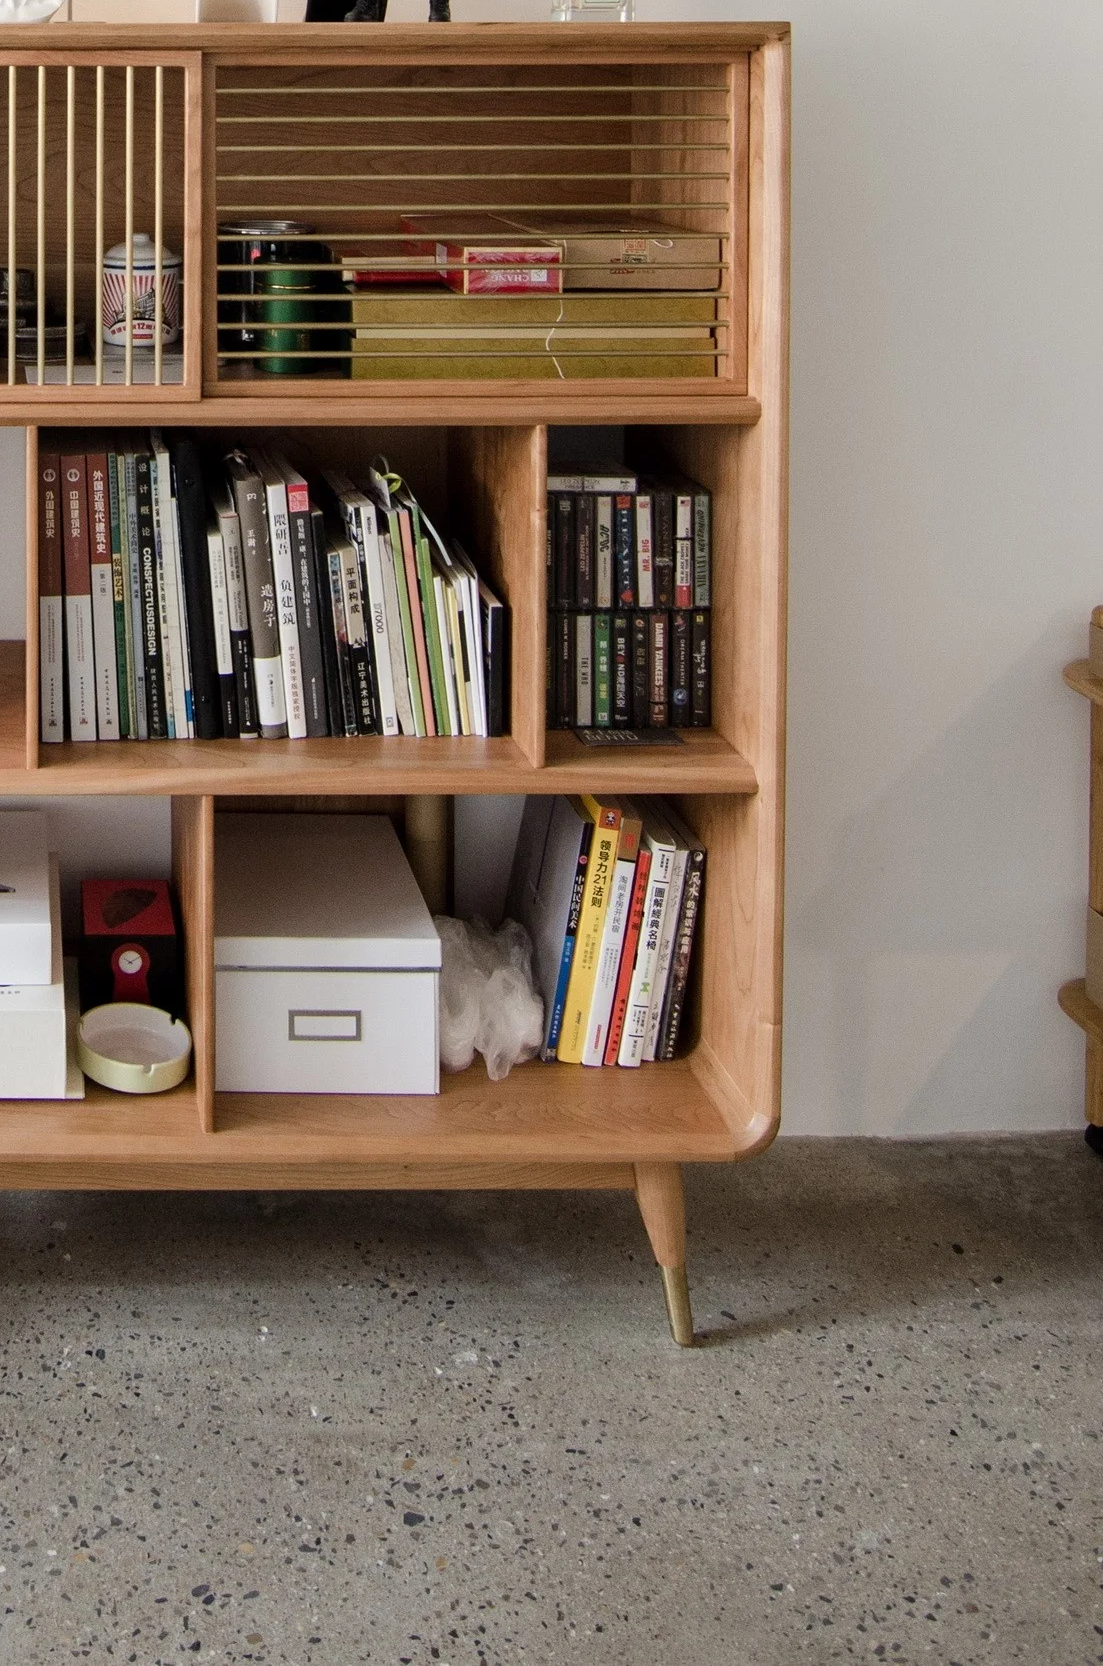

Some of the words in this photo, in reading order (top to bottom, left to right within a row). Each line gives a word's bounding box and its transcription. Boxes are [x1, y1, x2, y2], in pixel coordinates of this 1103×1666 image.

[45, 491, 55, 538] 外国建筑史
[69, 490, 81, 537] 中国建筑史
[92, 470, 108, 554] 外国近现代建筑史
[138, 463, 152, 537] 设计概论
[642, 538, 651, 552] BIG
[697, 509, 706, 552] NEVERMIND
[642, 554, 651, 572] MR.
[142, 547, 158, 656] CONSPECTUSDESIGN
[280, 580, 297, 626] 负建筑
[346, 567, 360, 615] 平面构成
[655, 623, 664, 647] DAMN
[580, 672, 588, 685] WHO
[654, 649, 664, 686] YANKEES
[356, 662, 371, 725] 辽宁美术出版社
[590, 840, 613, 909] 领导力21法则
[568, 875, 586, 929] 中国民间美术
